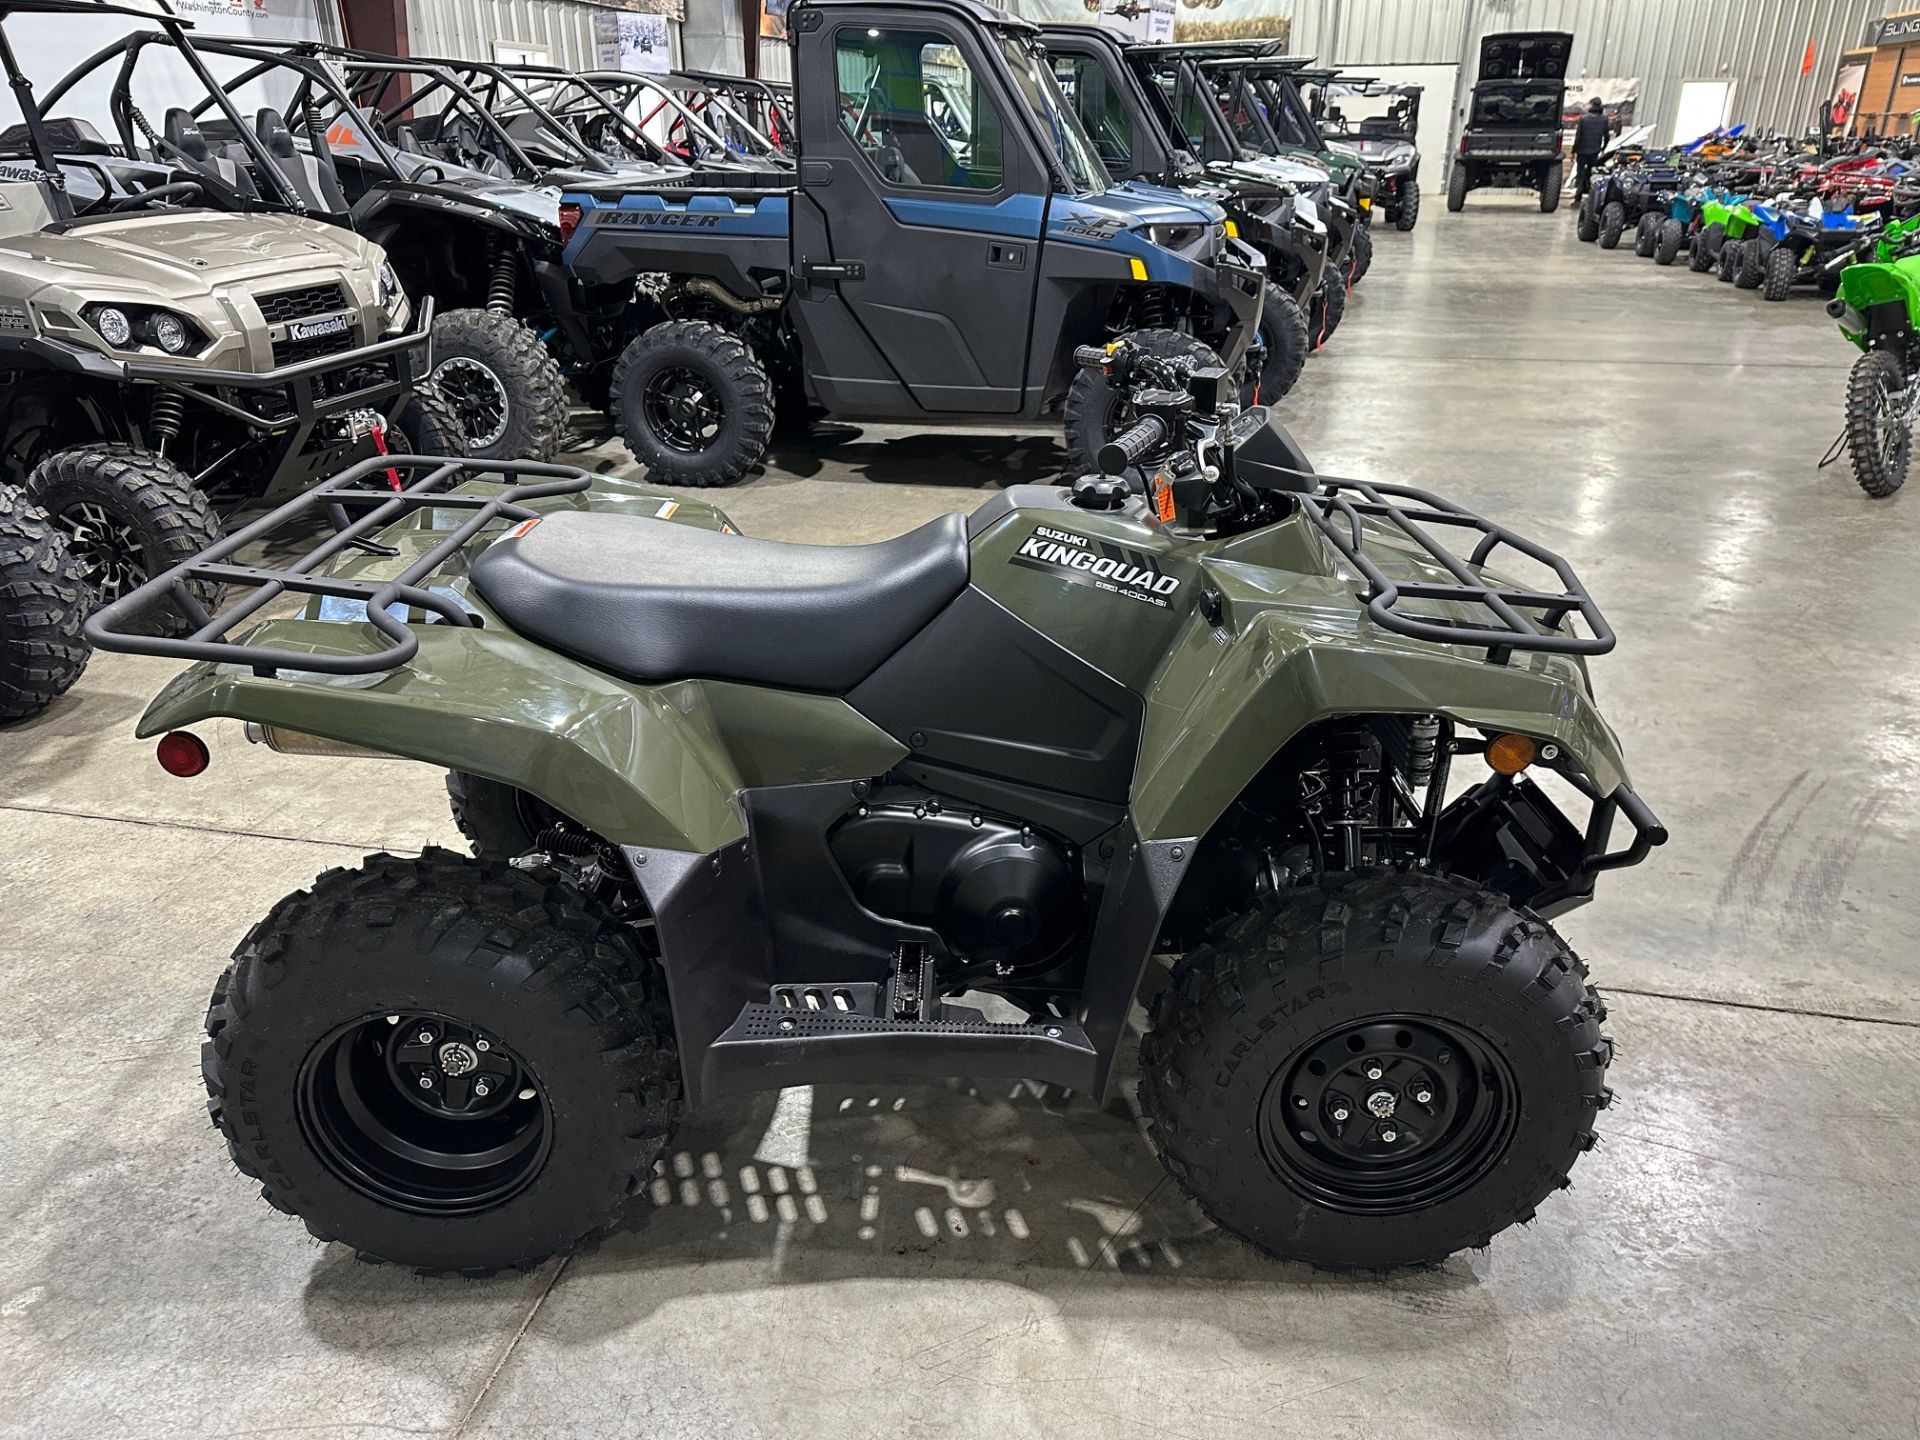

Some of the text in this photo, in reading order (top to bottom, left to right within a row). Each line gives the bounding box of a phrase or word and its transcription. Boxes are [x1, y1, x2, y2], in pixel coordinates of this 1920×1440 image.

[1885, 19, 1920, 36] SLING
[597, 211, 720, 227] RANGER
[1060, 211, 1128, 229] XP
[1066, 226, 1116, 240] 1000
[290, 315, 348, 340] Kawasaki
[1036, 526, 1088, 547] SUZUKI
[1019, 538, 1180, 595] KINGQUAD
[1215, 986, 1327, 1089] CARLSTAR
[239, 1058, 296, 1190] CARLSTAR
